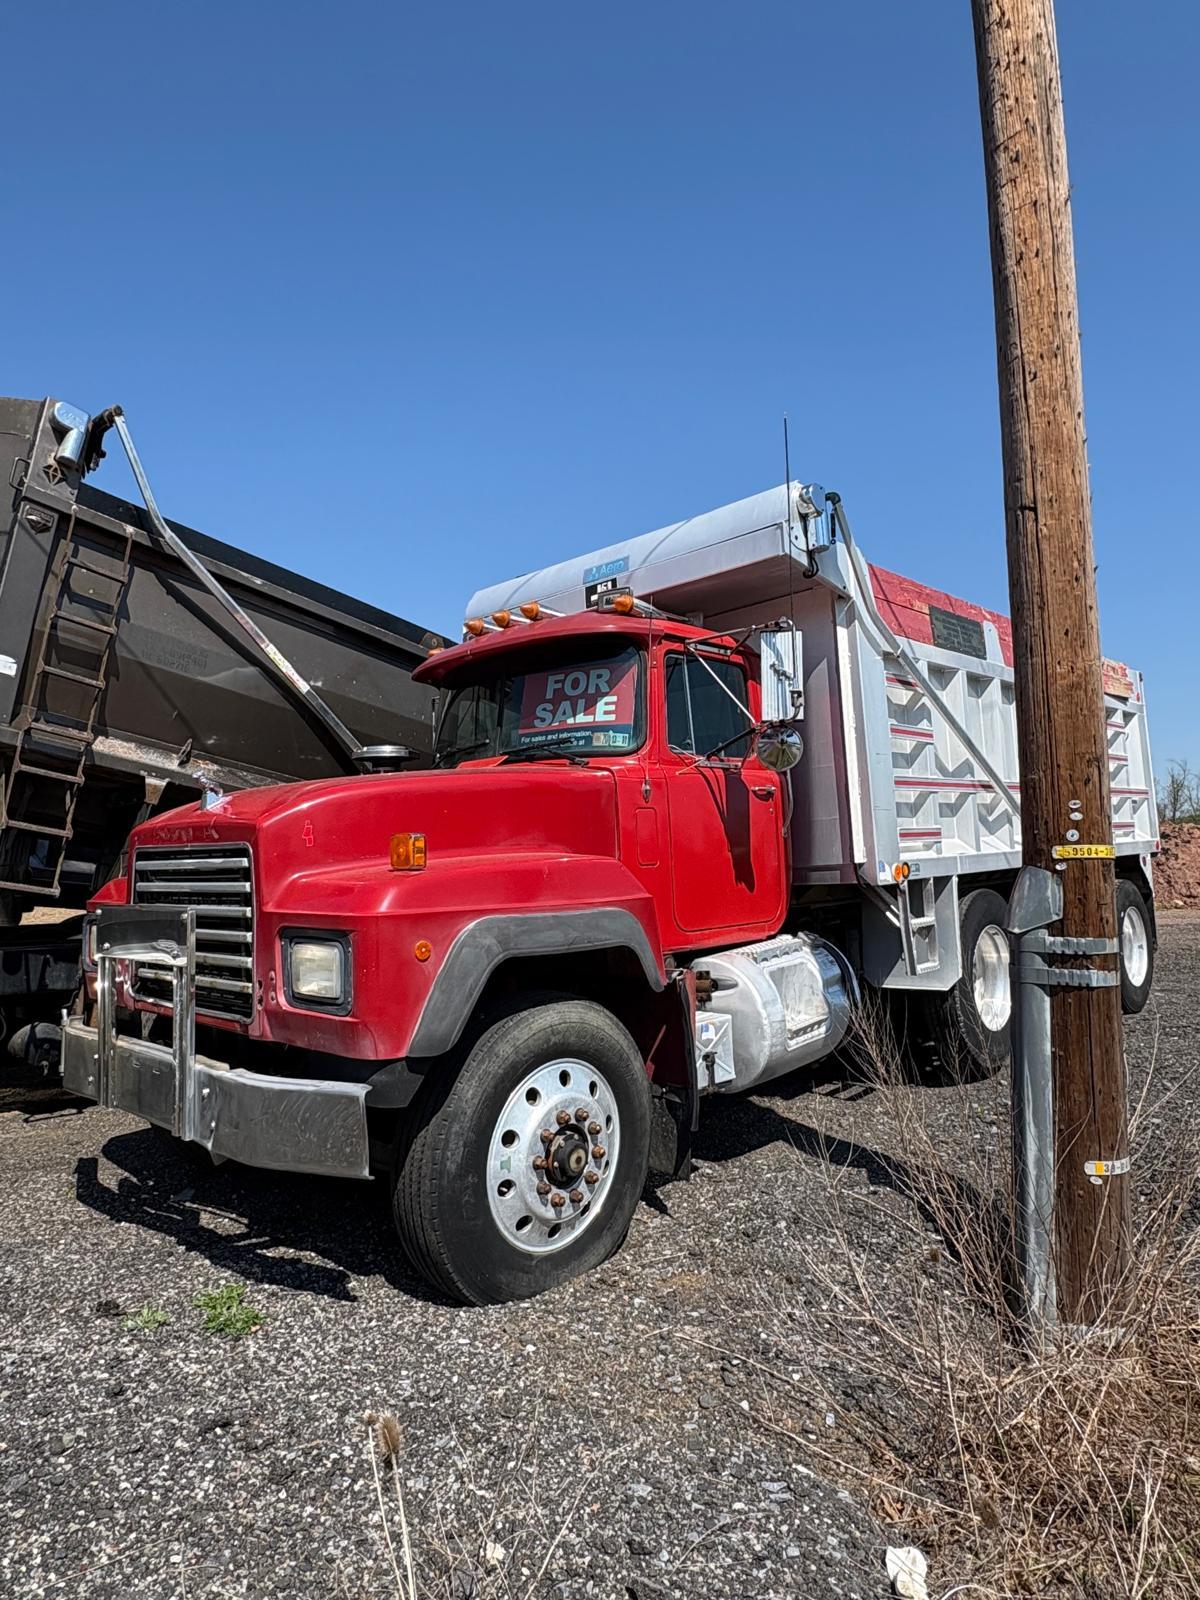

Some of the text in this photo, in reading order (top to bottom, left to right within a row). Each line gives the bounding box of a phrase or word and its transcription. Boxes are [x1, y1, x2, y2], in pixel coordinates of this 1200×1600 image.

[600, 560, 625, 576] Aero
[545, 668, 611, 699] FOR
[533, 695, 618, 728] SALE
[520, 736, 531, 744] For
[532, 735, 546, 743] sales
[547, 733, 559, 741] and
